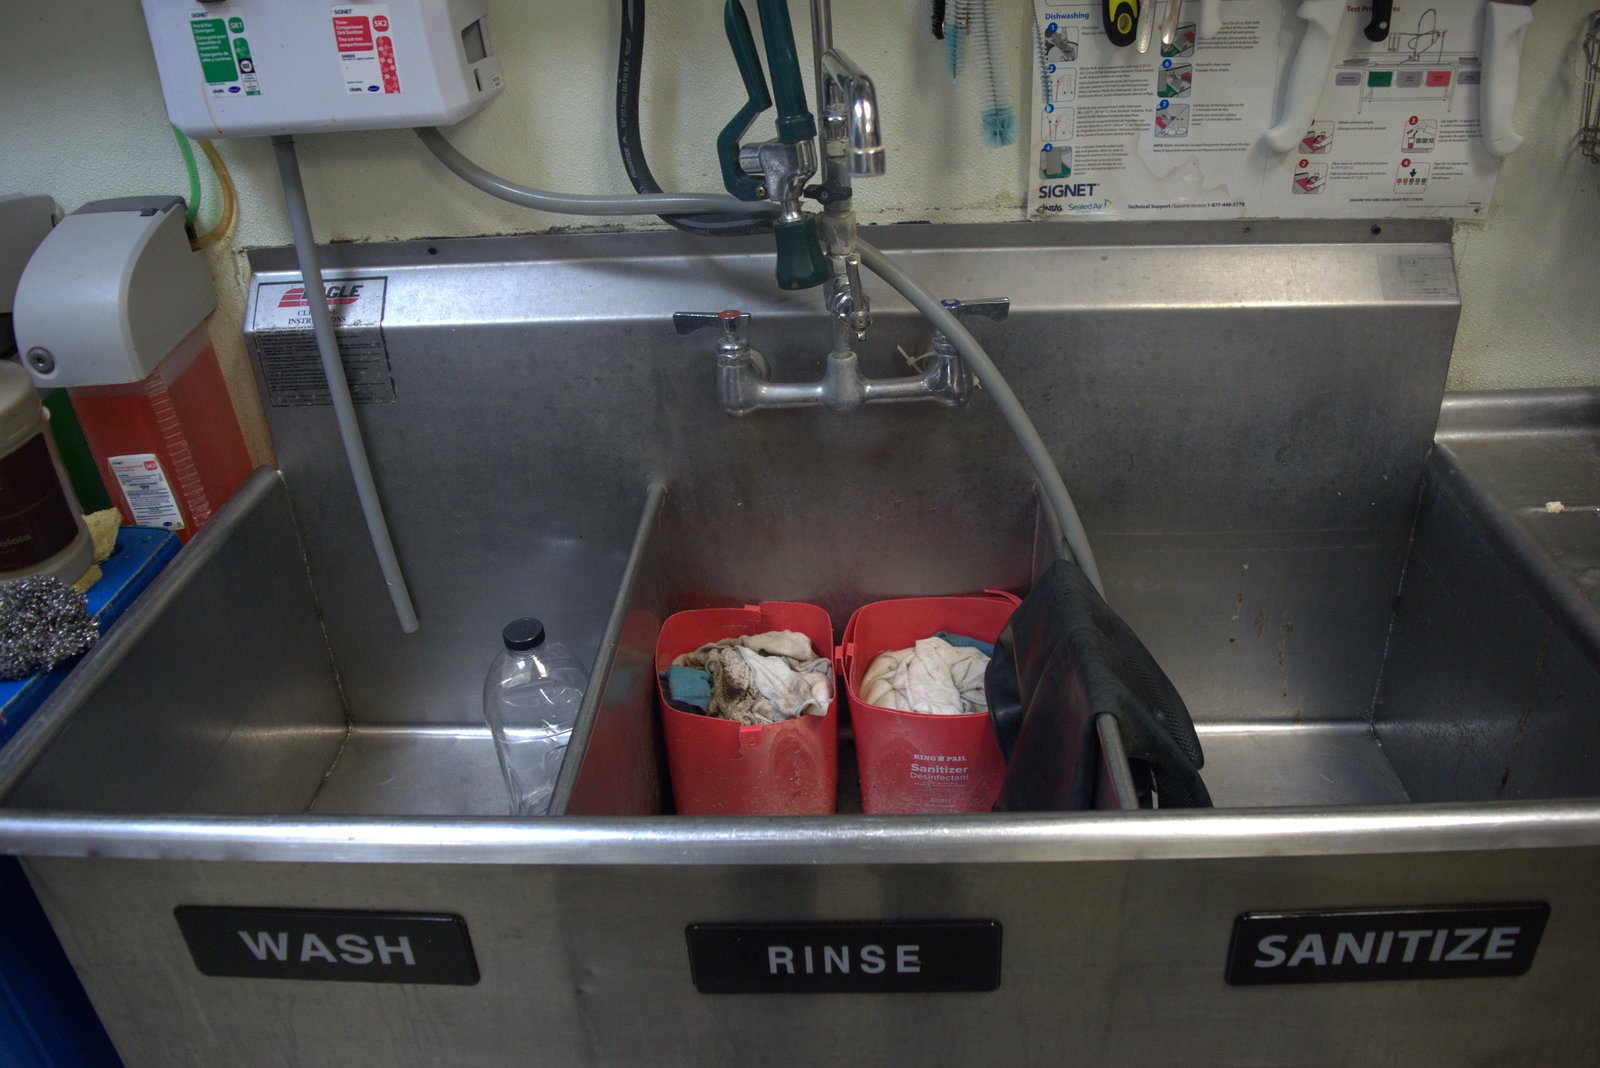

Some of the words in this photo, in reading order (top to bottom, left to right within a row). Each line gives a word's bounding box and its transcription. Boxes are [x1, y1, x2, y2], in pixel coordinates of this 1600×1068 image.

[1045, 12, 1090, 20] Dishwashing
[1038, 184, 1097, 198] SIGNET
[911, 764, 968, 774] Sanitizer
[238, 930, 416, 966] WASH
[1253, 927, 1520, 968] SANITIZE
[768, 945, 921, 974] RINSE
